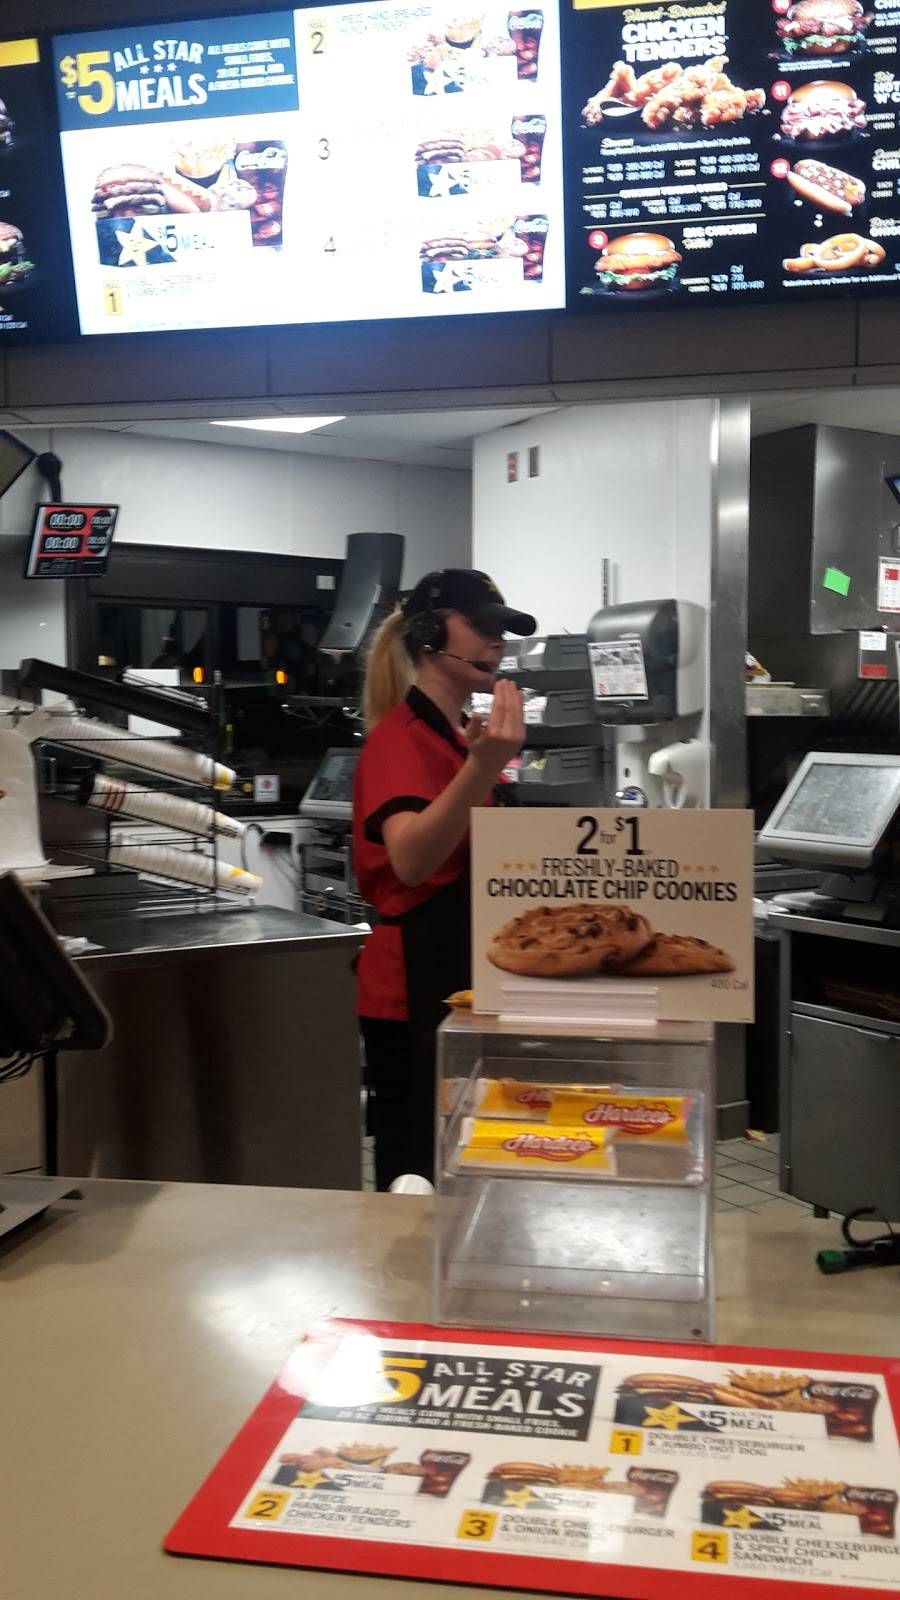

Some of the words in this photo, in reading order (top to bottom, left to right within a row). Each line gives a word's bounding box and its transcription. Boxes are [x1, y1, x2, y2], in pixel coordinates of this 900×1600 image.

[622, 15, 725, 43] CHICKEN
[311, 31, 324, 54] 2
[622, 36, 726, 62] TENDERS
[113, 44, 150, 72] ALL
[153, 40, 204, 64] STAR
[59, 51, 115, 115] $5
[116, 73, 207, 112] MEALS
[318, 138, 330, 160] 3
[108, 290, 118, 313] 1
[576, 815, 598, 855] 2
[600, 830, 617, 845] for
[615, 816, 645, 856] $1
[541, 857, 679, 878] FRESHLY-BAKED
[487, 878, 598, 898] CHOCOLATE
[603, 880, 647, 900] CHIP
[653, 881, 737, 902] COOKIES
[733, 979, 748, 990] Cal
[433, 1361, 494, 1377] ALL
[505, 1362, 593, 1388] STAR
[417, 1383, 587, 1418] MEALS
[699, 1410, 728, 1428] $5
[729, 1418, 777, 1432] MEAL
[621, 1438, 632, 1452] 1
[709, 1444, 734, 1454] HOT
[740, 1447, 768, 1457] DOG
[254, 1499, 277, 1517] 2
[286, 1509, 345, 1522] CHICKEN
[465, 1519, 489, 1537] 3
[503, 1514, 559, 1527] DOUBLE
[514, 1524, 561, 1534] ONION
[765, 1512, 786, 1528] $5
[786, 1520, 824, 1531] MEAL
[733, 1532, 789, 1545] DOUBLE
[698, 1541, 722, 1559] 4
[733, 1551, 814, 1567] SANDWICH
[734, 1542, 744, 1550] &
[748, 1543, 789, 1555] SPICY
[794, 1547, 860, 1561] CHICKEN
